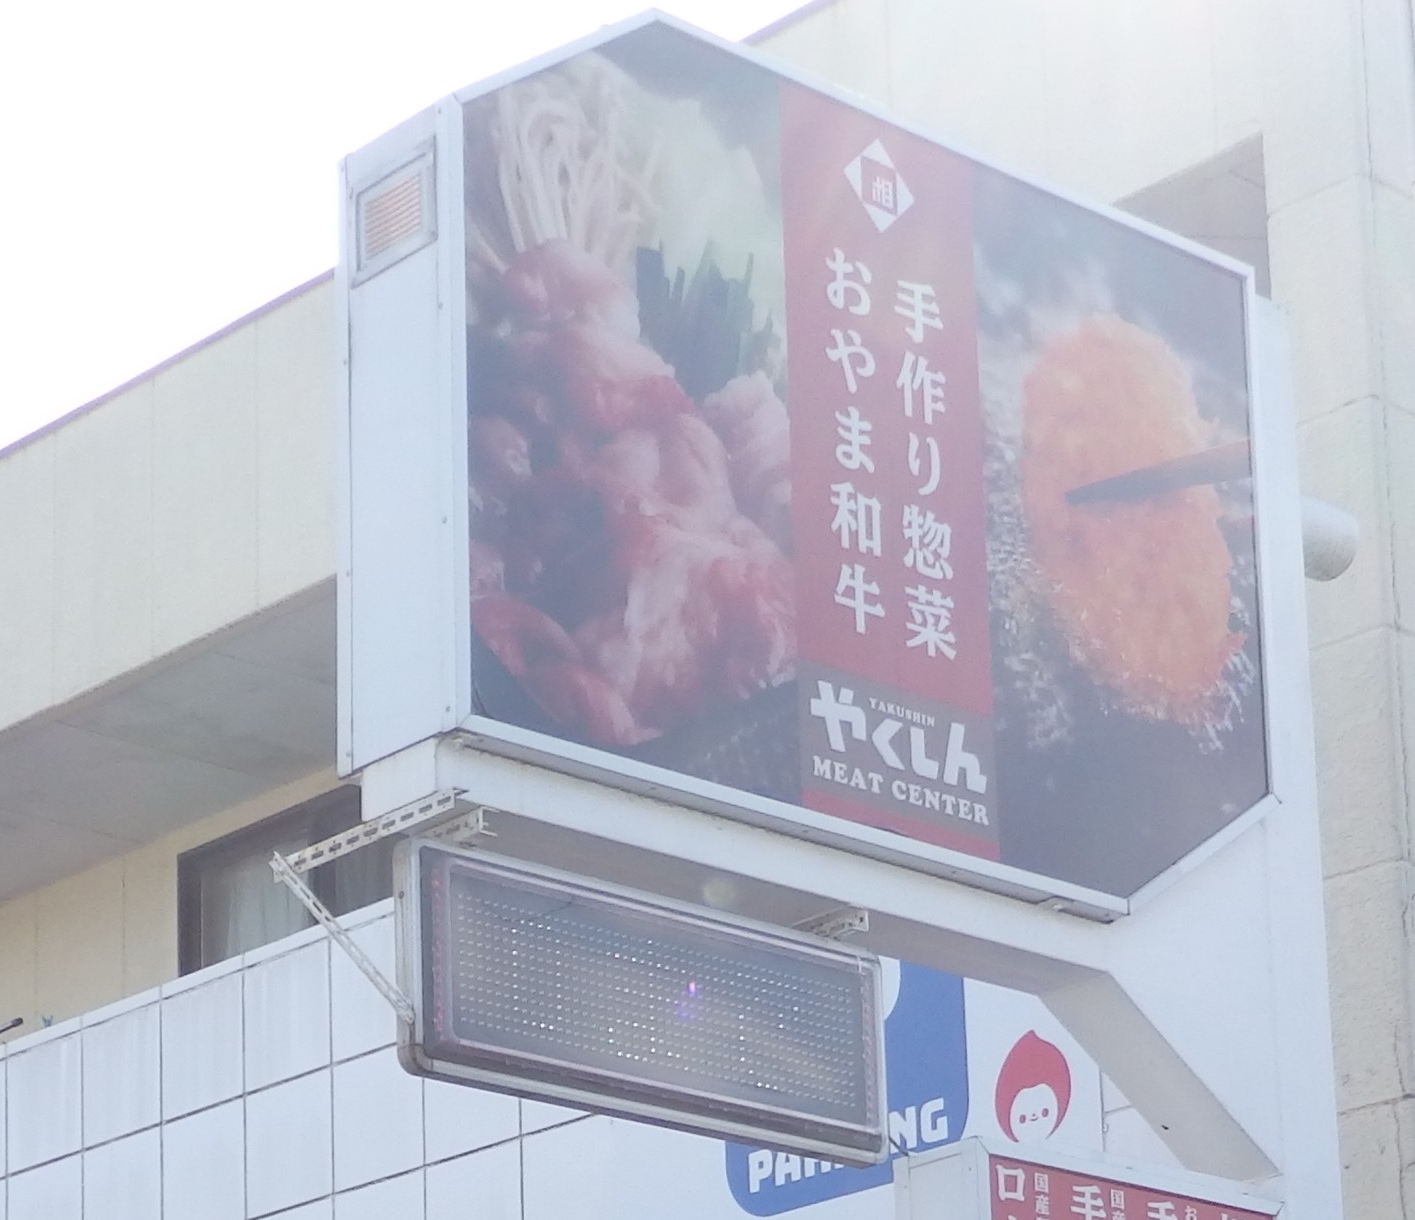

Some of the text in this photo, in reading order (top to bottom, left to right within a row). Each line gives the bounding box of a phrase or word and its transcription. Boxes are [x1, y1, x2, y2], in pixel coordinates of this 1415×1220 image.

[825, 247, 885, 635] おやま和牛
[894, 279, 957, 661] 手作り惣菜
[810, 679, 988, 794] やくしん
[869, 697, 935, 727] YAKUSHIN
[813, 755, 989, 826] MEAT CENTER
